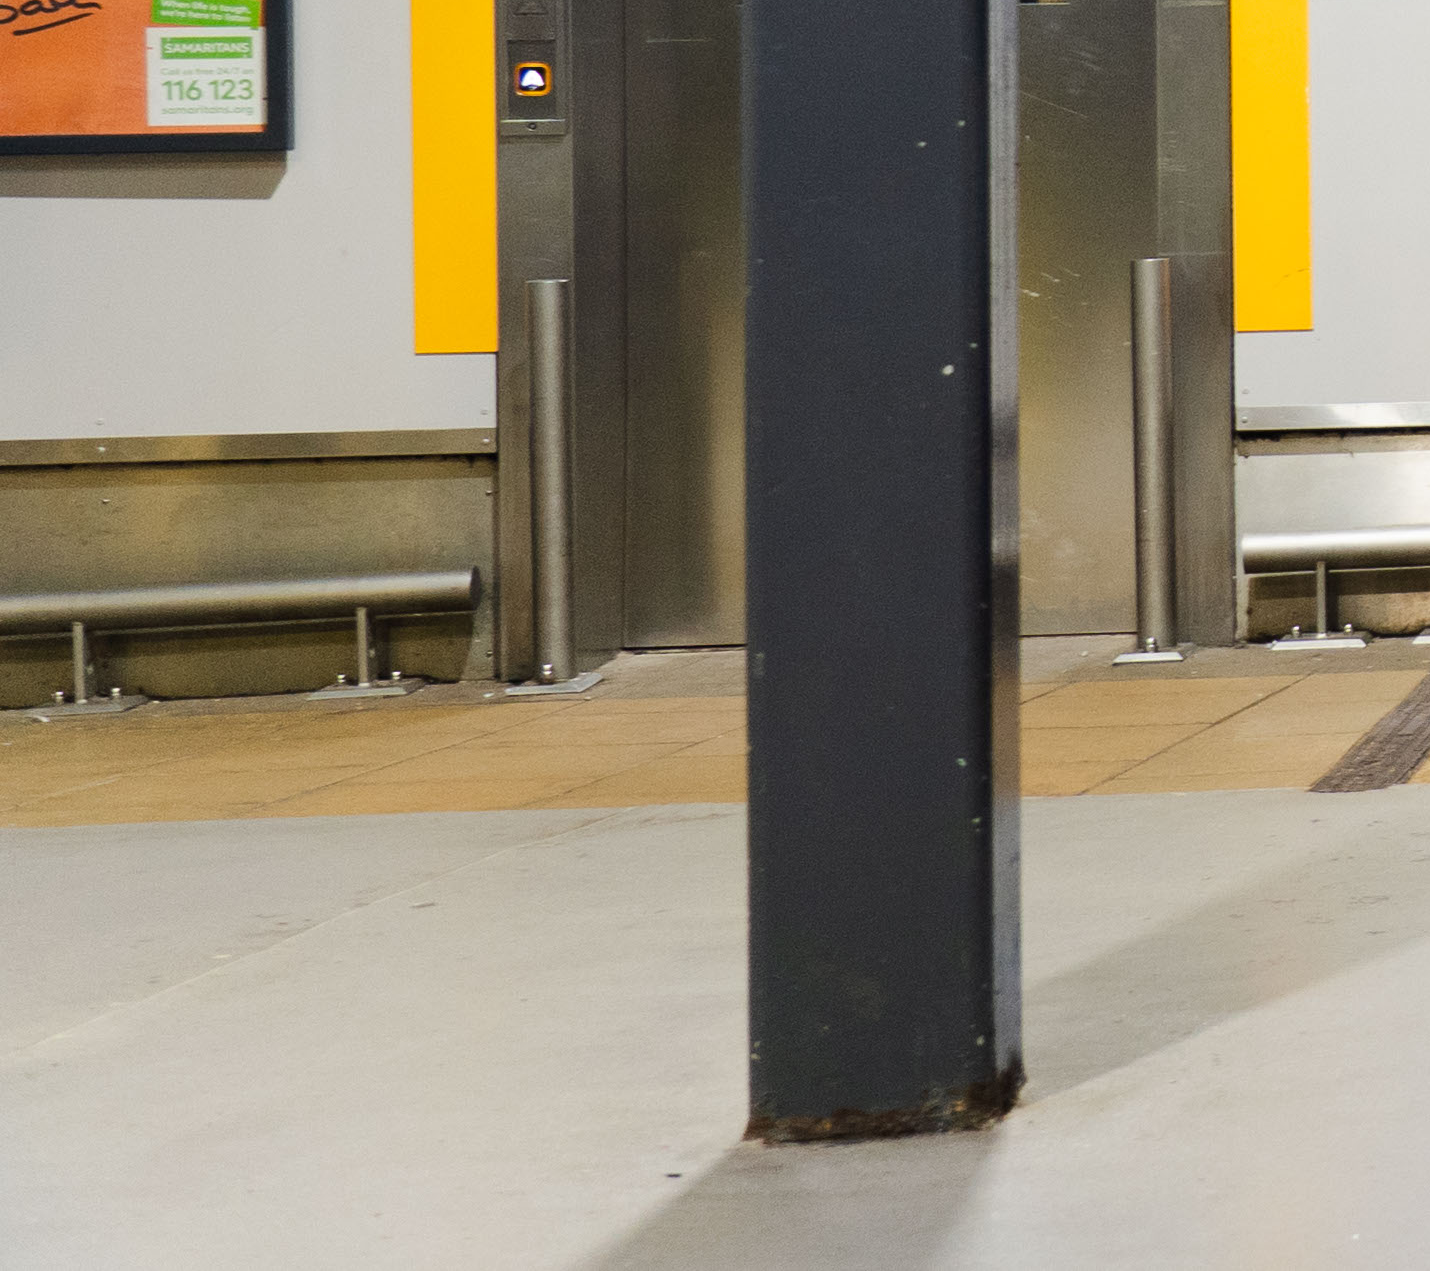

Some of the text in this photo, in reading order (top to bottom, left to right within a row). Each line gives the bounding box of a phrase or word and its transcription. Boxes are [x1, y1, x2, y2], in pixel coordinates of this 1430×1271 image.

[164, 42, 250, 54] SAMARITANS
[162, 79, 255, 101] 116 123
